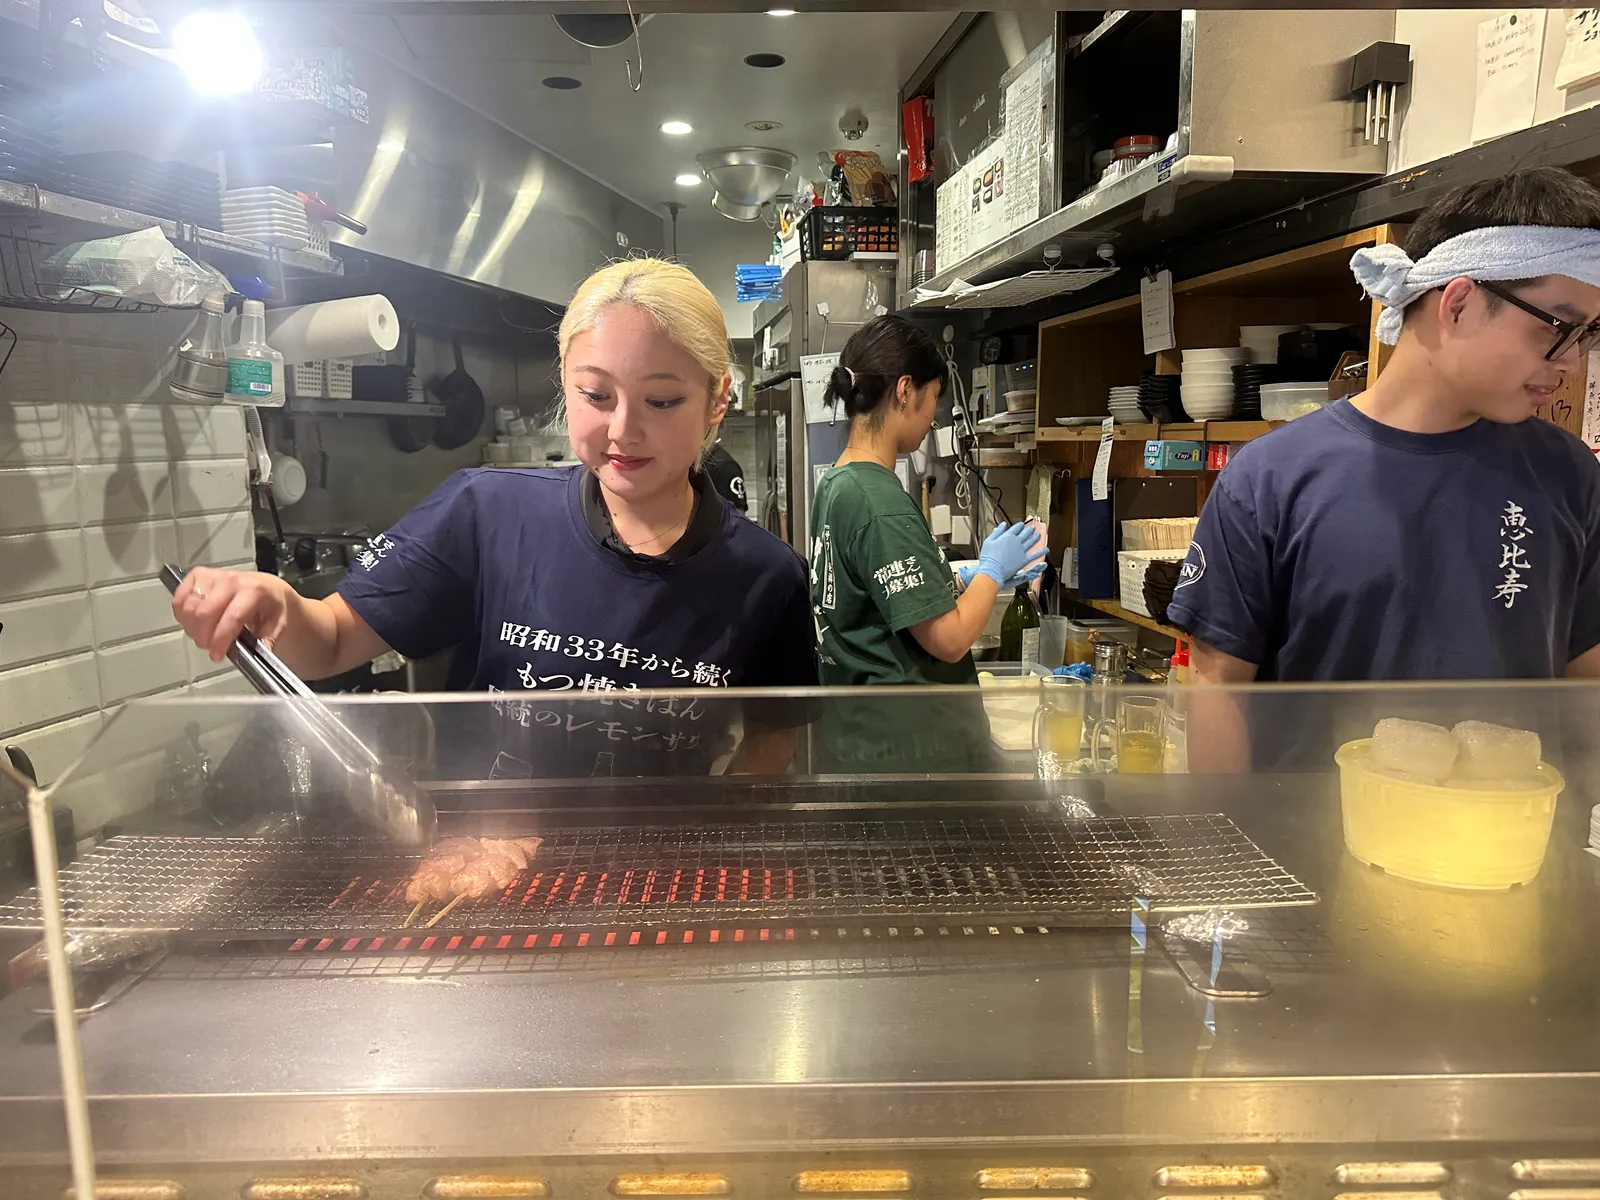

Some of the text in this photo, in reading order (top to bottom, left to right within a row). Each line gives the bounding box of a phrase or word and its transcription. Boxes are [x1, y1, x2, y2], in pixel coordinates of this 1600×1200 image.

[1491, 500, 1534, 608] 恵比寿
[499, 621, 732, 689] 昭和33年から続く
